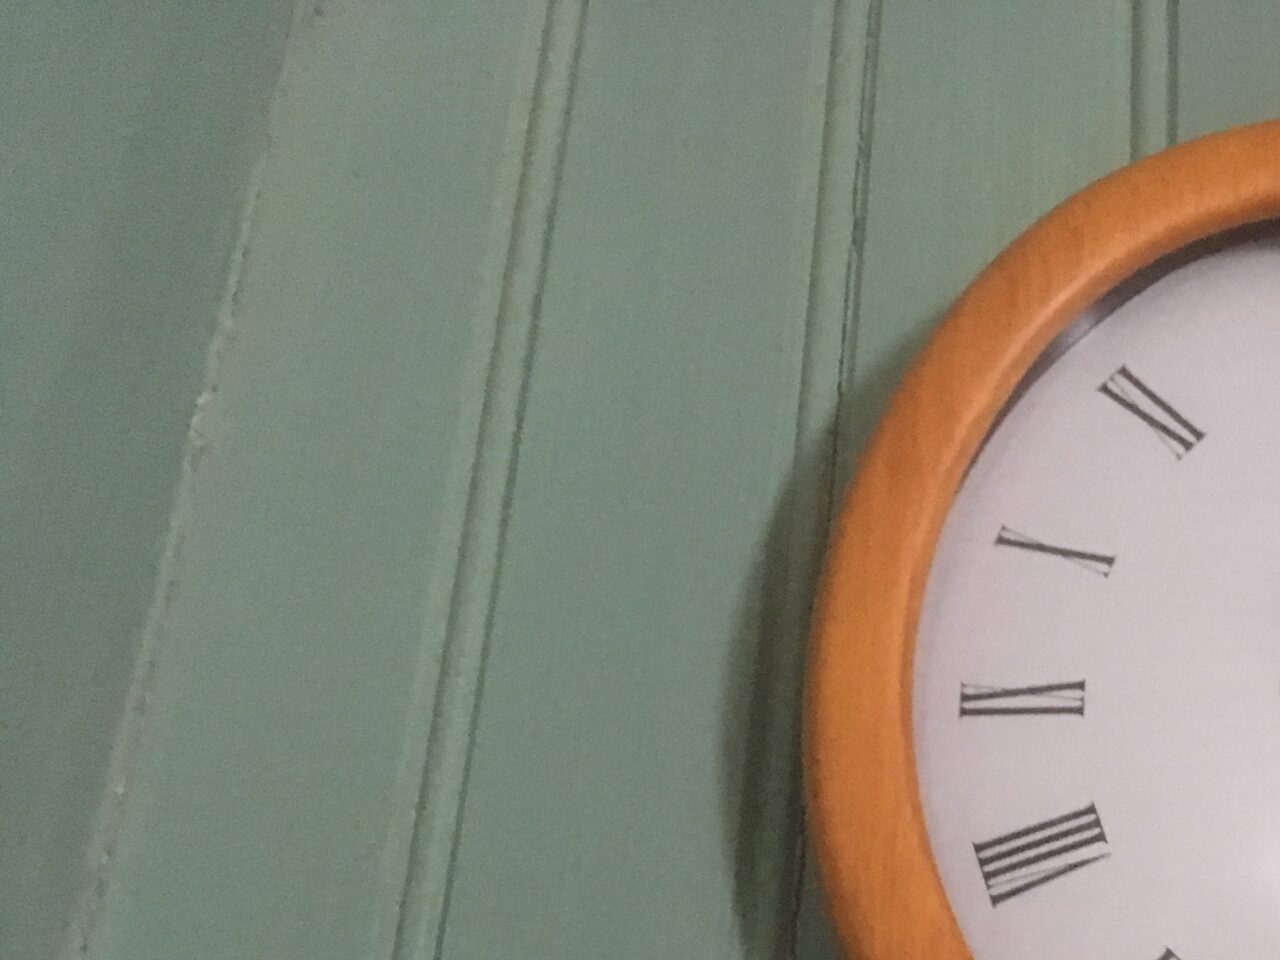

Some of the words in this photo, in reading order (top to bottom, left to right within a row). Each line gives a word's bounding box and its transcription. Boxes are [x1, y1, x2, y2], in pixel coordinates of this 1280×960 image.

[1097, 365, 1206, 460] XI
[995, 525, 1117, 578] X
[958, 679, 1087, 718] IX
[972, 801, 1111, 908] VIII
